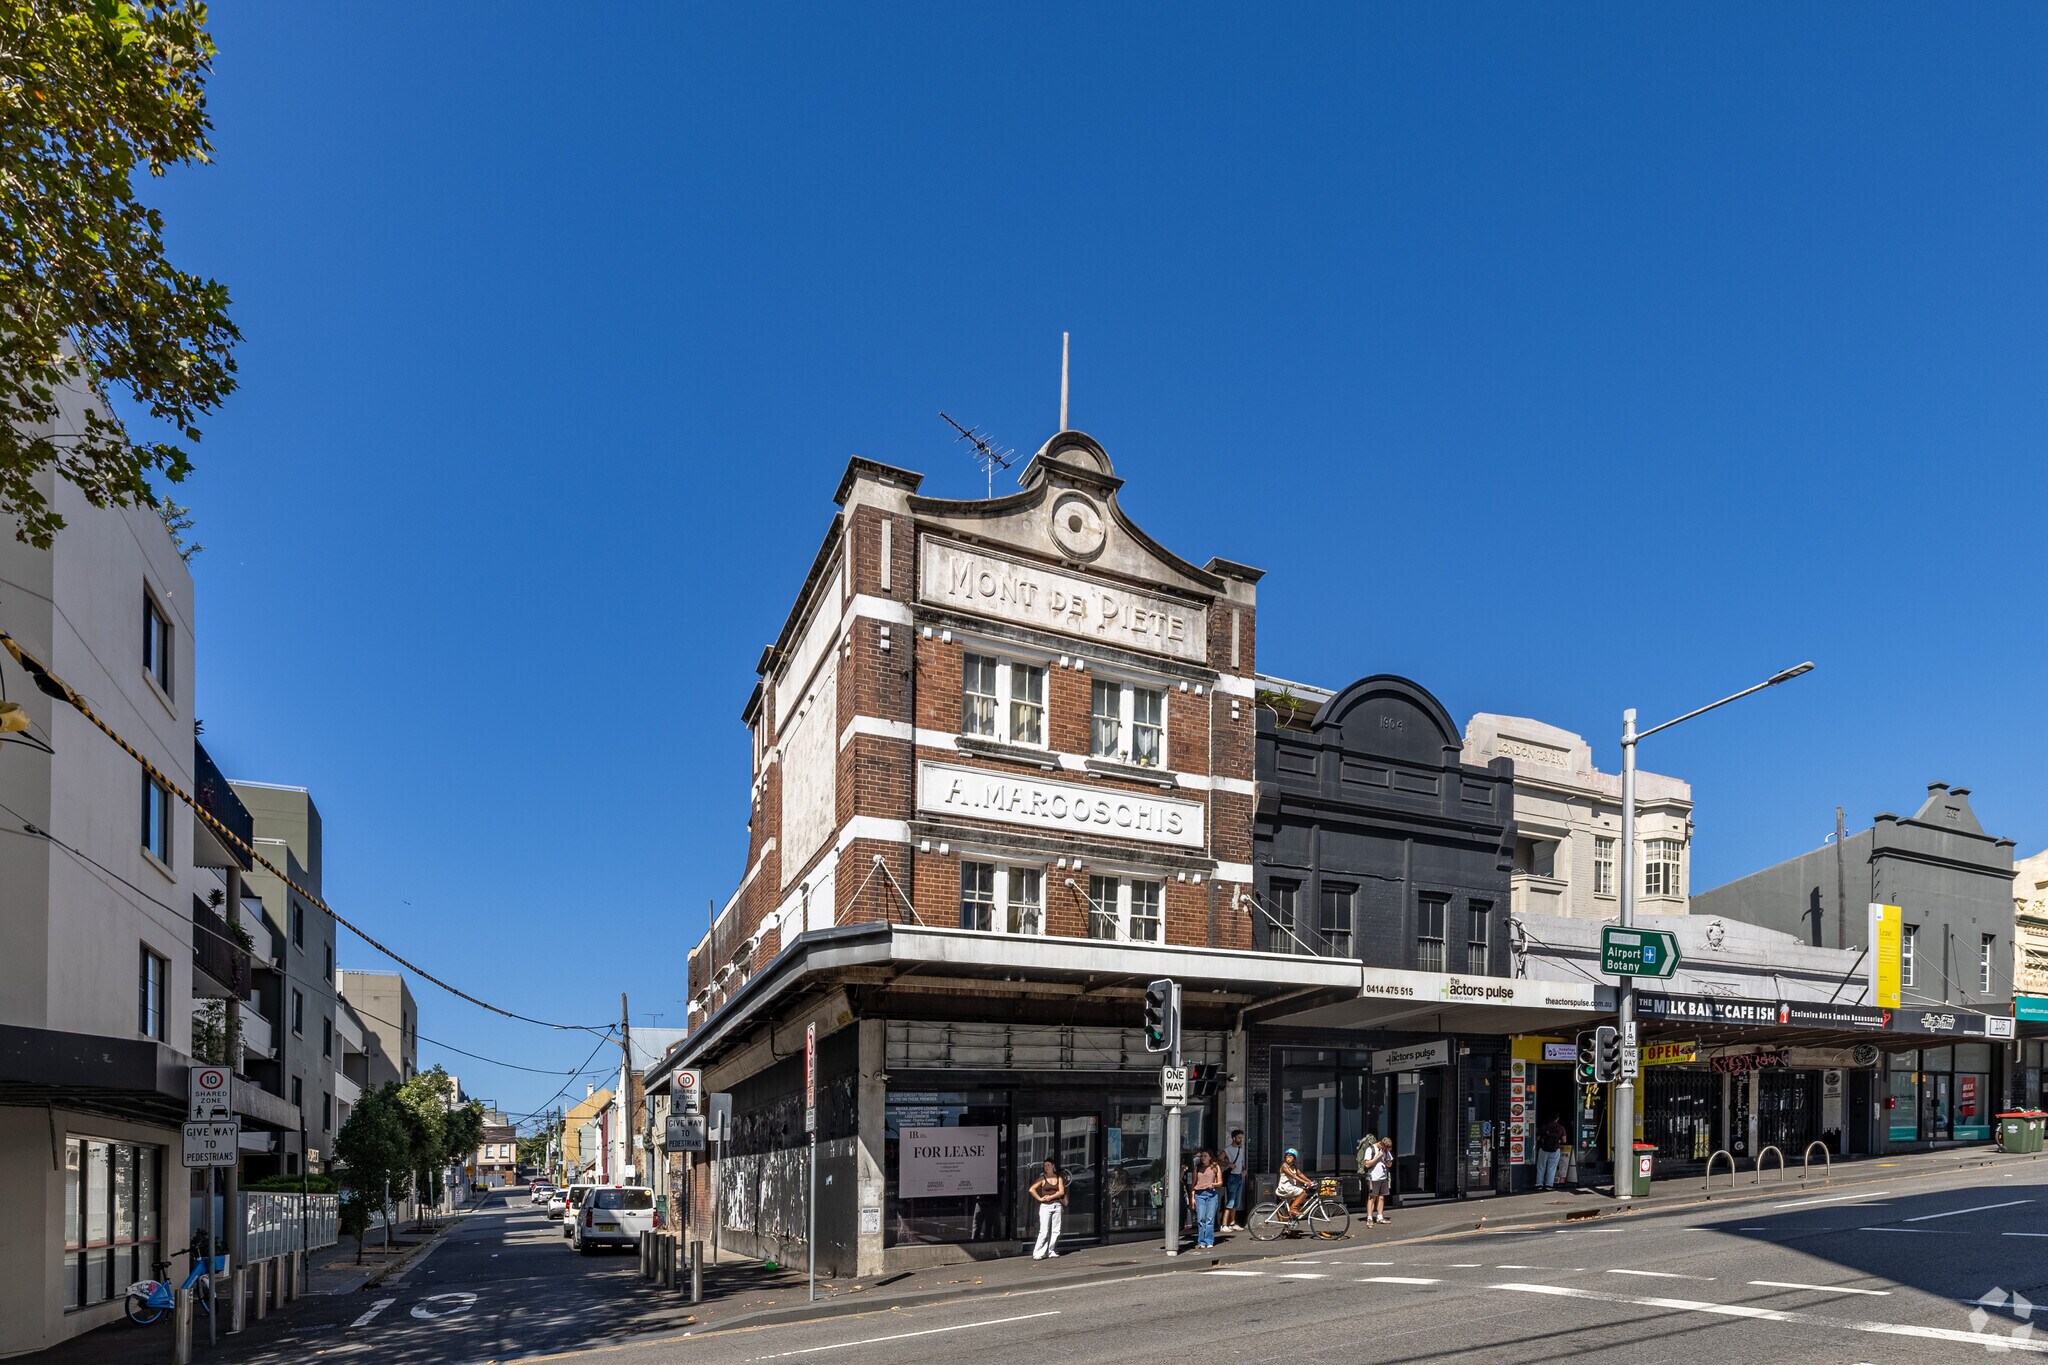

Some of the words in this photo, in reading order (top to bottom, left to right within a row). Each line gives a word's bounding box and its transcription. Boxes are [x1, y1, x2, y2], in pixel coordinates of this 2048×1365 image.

[948, 556, 1038, 607] MONT
[1051, 590, 1083, 616] DE
[1097, 592, 1184, 641] PIETE
[1380, 715, 1404, 733] 1904
[1498, 742, 1535, 759] LONDON
[1536, 749, 1568, 767] TAVERN
[1607, 946, 1641, 959] Airport
[1607, 959, 1640, 973] Botany
[1450, 977, 1460, 985] the
[1366, 984, 1384, 994] 0414
[1385, 985, 1399, 995] 475
[1400, 986, 1414, 996] 515
[1450, 983, 1484, 997] actors
[1485, 985, 1514, 1000] pulse
[1545, 997, 1612, 1008] theactorspulse.com.au
[1639, 998, 1652, 1006] THE
[1653, 999, 1687, 1015] MILK
[1688, 1001, 1713, 1017] BAR
[1715, 1004, 1724, 1012] BY
[1725, 1004, 1754, 1019] CAFE
[1756, 1006, 1775, 1021] ISH
[1791, 1009, 1818, 1019] Exclusive
[1819, 1011, 1828, 1020] Art
[1833, 1013, 1850, 1021] Smoke
[1851, 1014, 1883, 1023] Accessories
[1391, 1052, 1414, 1062] actors
[1415, 1049, 1435, 1060] pulse
[1624, 1050, 1636, 1058] ONE
[1648, 1045, 1680, 1060] OPEN
[205, 1075, 217, 1085] 10
[682, 1076, 690, 1084] 10
[1166, 1070, 1184, 1080] ONE
[1165, 1082, 1184, 1091] WAY
[668, 1120, 685, 1128] GIVE
[687, 1119, 703, 1127] WAY
[186, 1128, 209, 1137] GIVE
[213, 1127, 235, 1136] WAY
[681, 1129, 690, 1137] TO
[205, 1140, 217, 1149] TO
[668, 1140, 702, 1148] PEDESTRIANS
[186, 1152, 234, 1162] PEDESTRIANS
[913, 1146, 941, 1159] FOR
[944, 1145, 985, 1158] LEASE
[350, 1291, 478, 1328] 10
